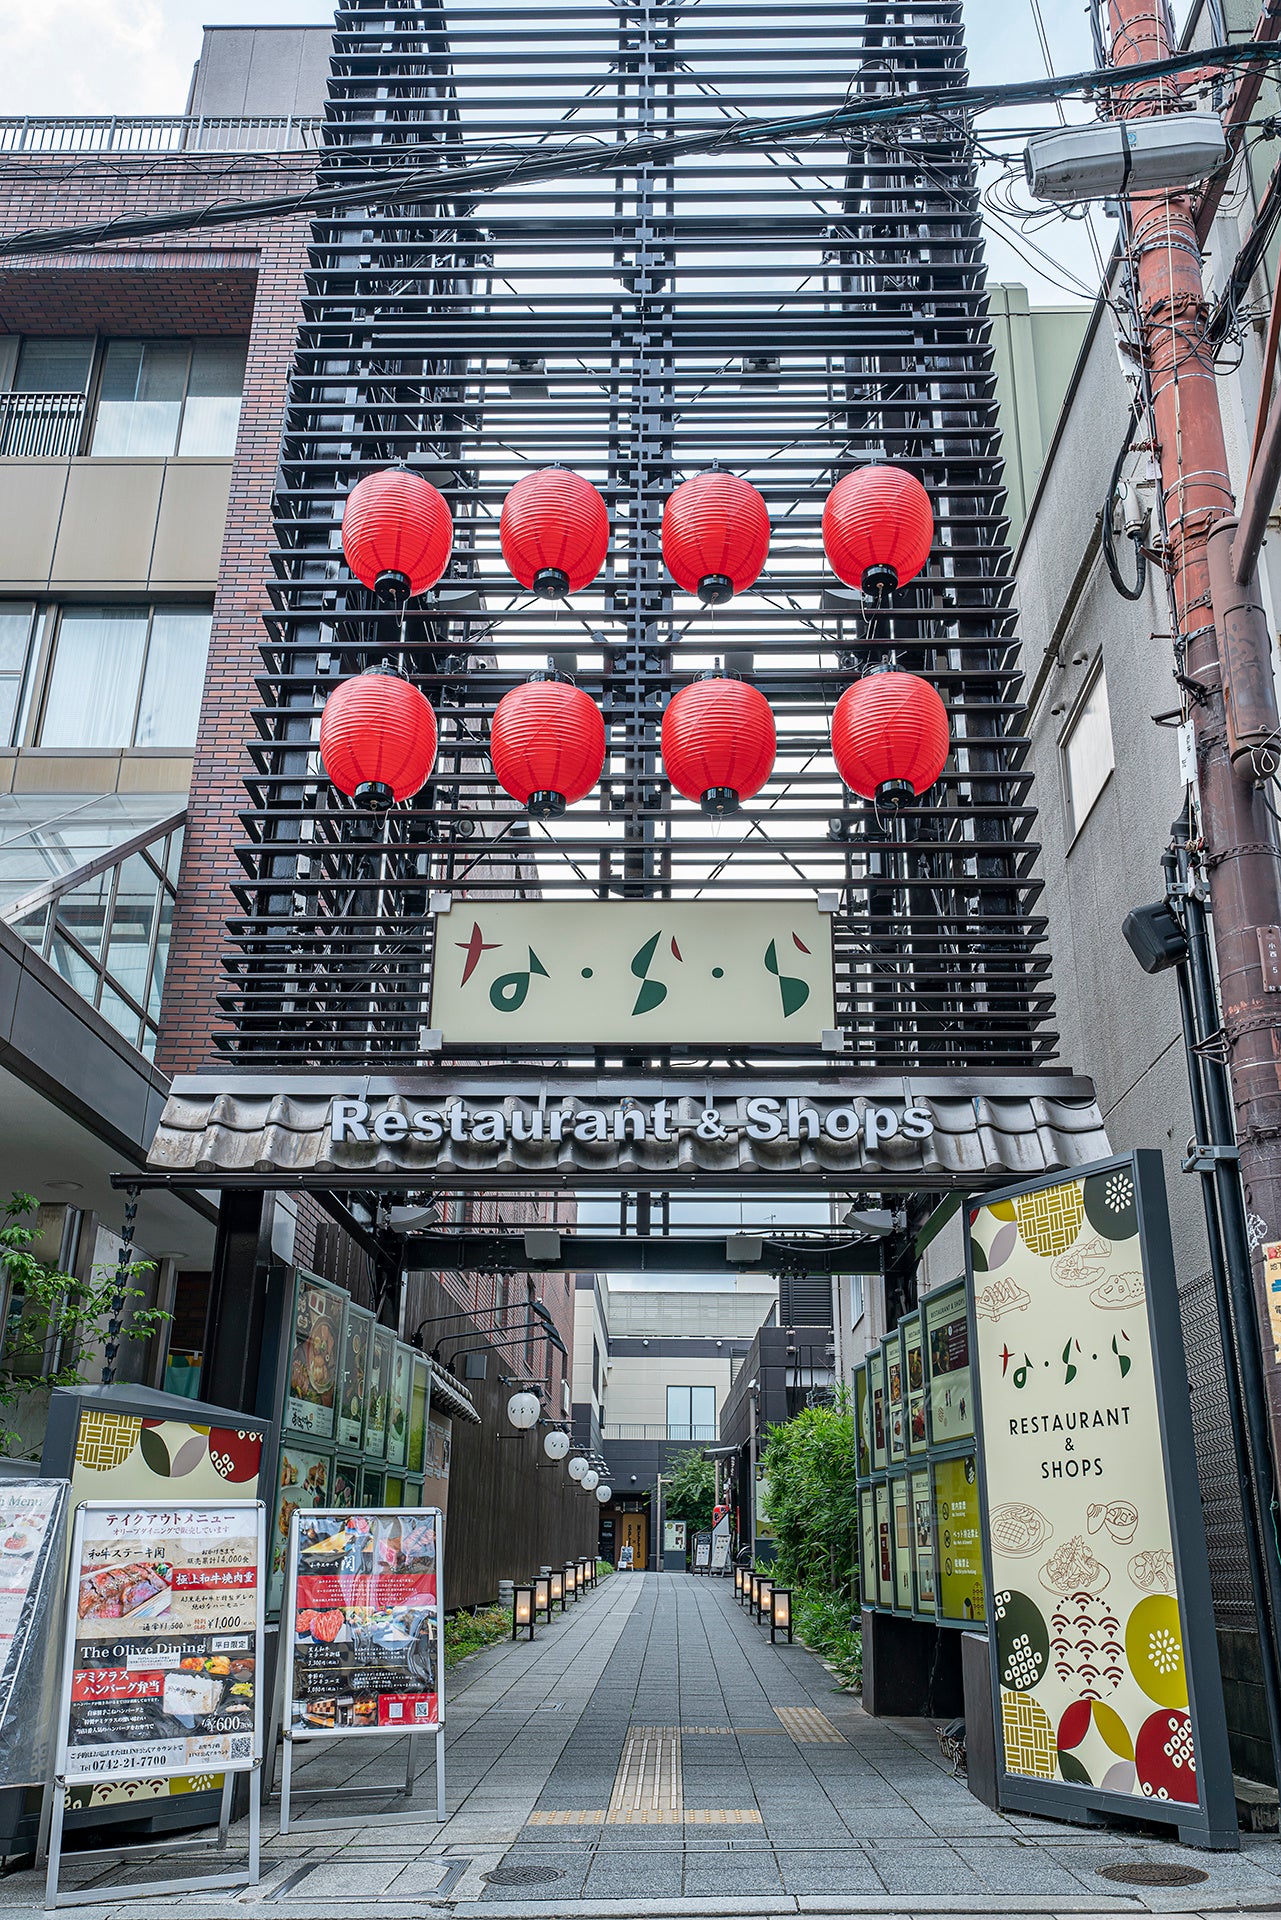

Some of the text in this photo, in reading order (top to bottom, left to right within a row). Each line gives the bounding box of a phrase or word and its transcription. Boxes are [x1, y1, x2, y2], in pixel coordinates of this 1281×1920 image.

[330, 1098, 934, 1150] Restaurant & Shops
[1009, 1406, 1130, 1436] RESTAURANT
[1064, 1437, 1075, 1452] &
[1041, 1457, 1104, 1479] SHOPS
[106, 1513, 236, 1526] テイクアウトメニュー
[113, 1526, 230, 1536] オリーブダイニングで販売しています
[207, 1616, 241, 1630] ¥1,000
[81, 1643, 206, 1659] The Olive Dining
[214, 1641, 247, 1649] 平日限定
[74, 1670, 129, 1685] デミグラス
[83, 1680, 160, 1696] ハンバーグ弁当
[81, 1755, 167, 1772] Tel 0742-21-7700
